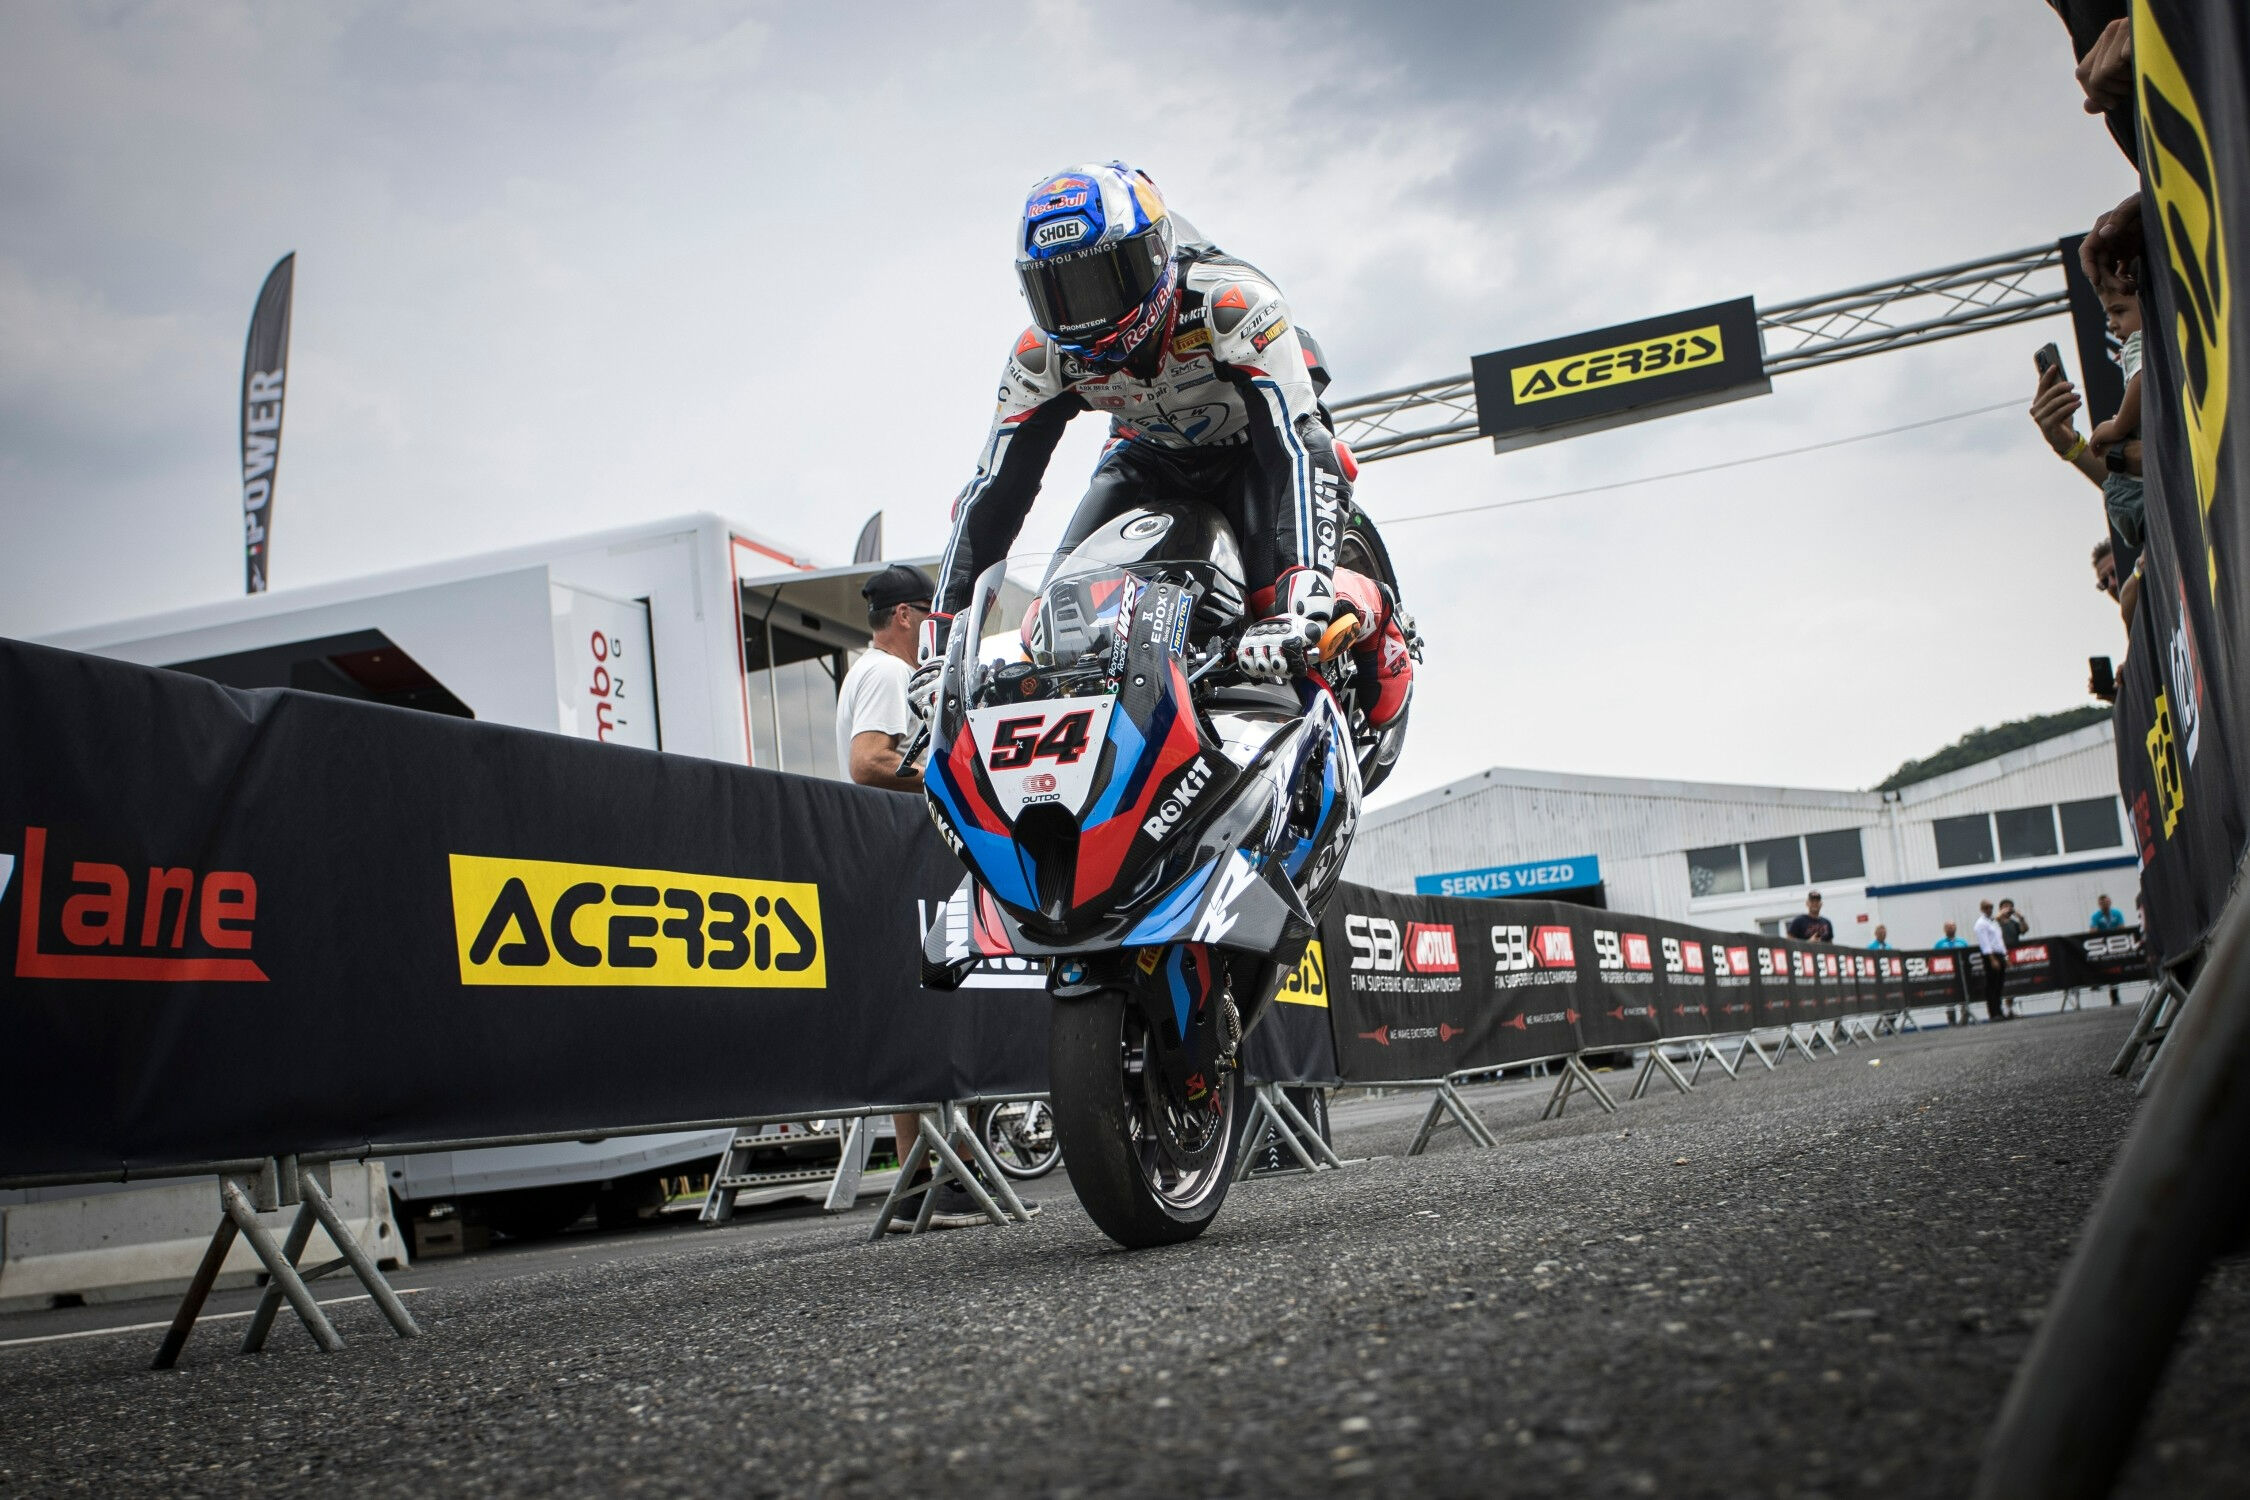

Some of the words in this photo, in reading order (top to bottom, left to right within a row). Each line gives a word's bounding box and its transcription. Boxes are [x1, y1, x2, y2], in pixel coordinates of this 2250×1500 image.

[1039, 218, 1080, 244] SHOEI
[1049, 254, 1072, 266] YOU
[1078, 241, 1118, 260] WINGS
[1059, 317, 1107, 332] PROMETEON
[244, 368, 285, 543] POWER
[1116, 575, 1137, 639] WRS
[1151, 597, 1168, 644] EDOX
[989, 709, 1095, 771] 54
[1022, 793, 1061, 804] OUTDO
[1440, 871, 1511, 897] SERVIS
[1515, 864, 1574, 888] VJEZD
[1415, 930, 1458, 966] MOTUL
